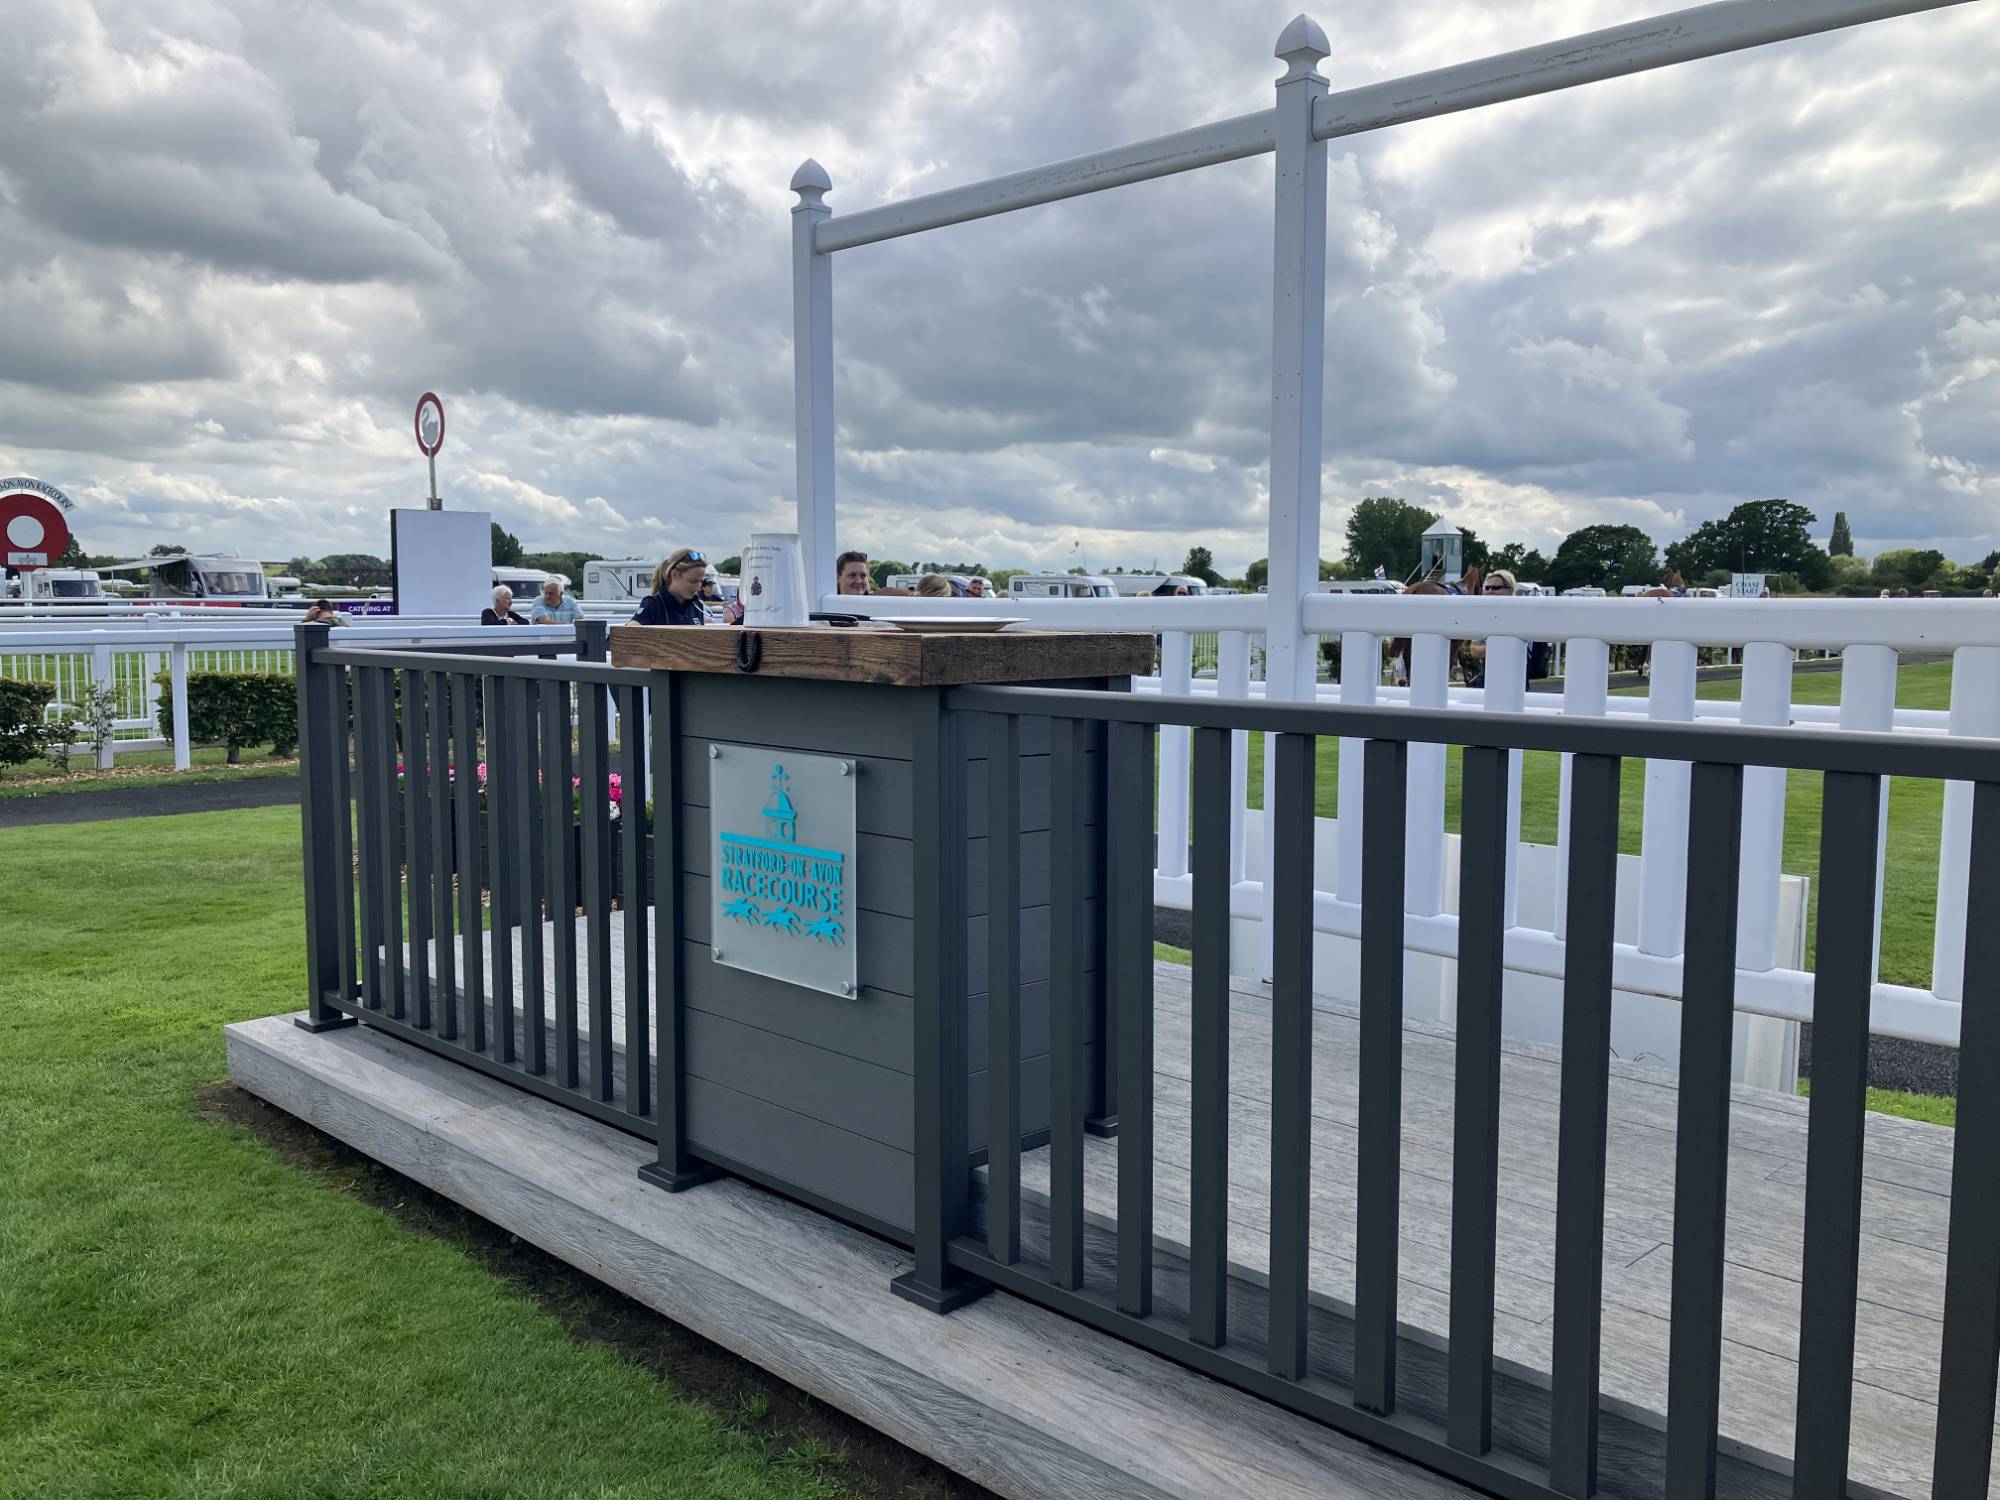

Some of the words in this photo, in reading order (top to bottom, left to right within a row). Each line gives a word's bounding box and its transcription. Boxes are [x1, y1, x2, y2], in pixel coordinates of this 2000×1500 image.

[36, 482, 73, 510] RACECOURSE
[721, 844, 843, 885] STRATFORD-ON-AVON
[721, 866, 843, 916] RACECOURSE
